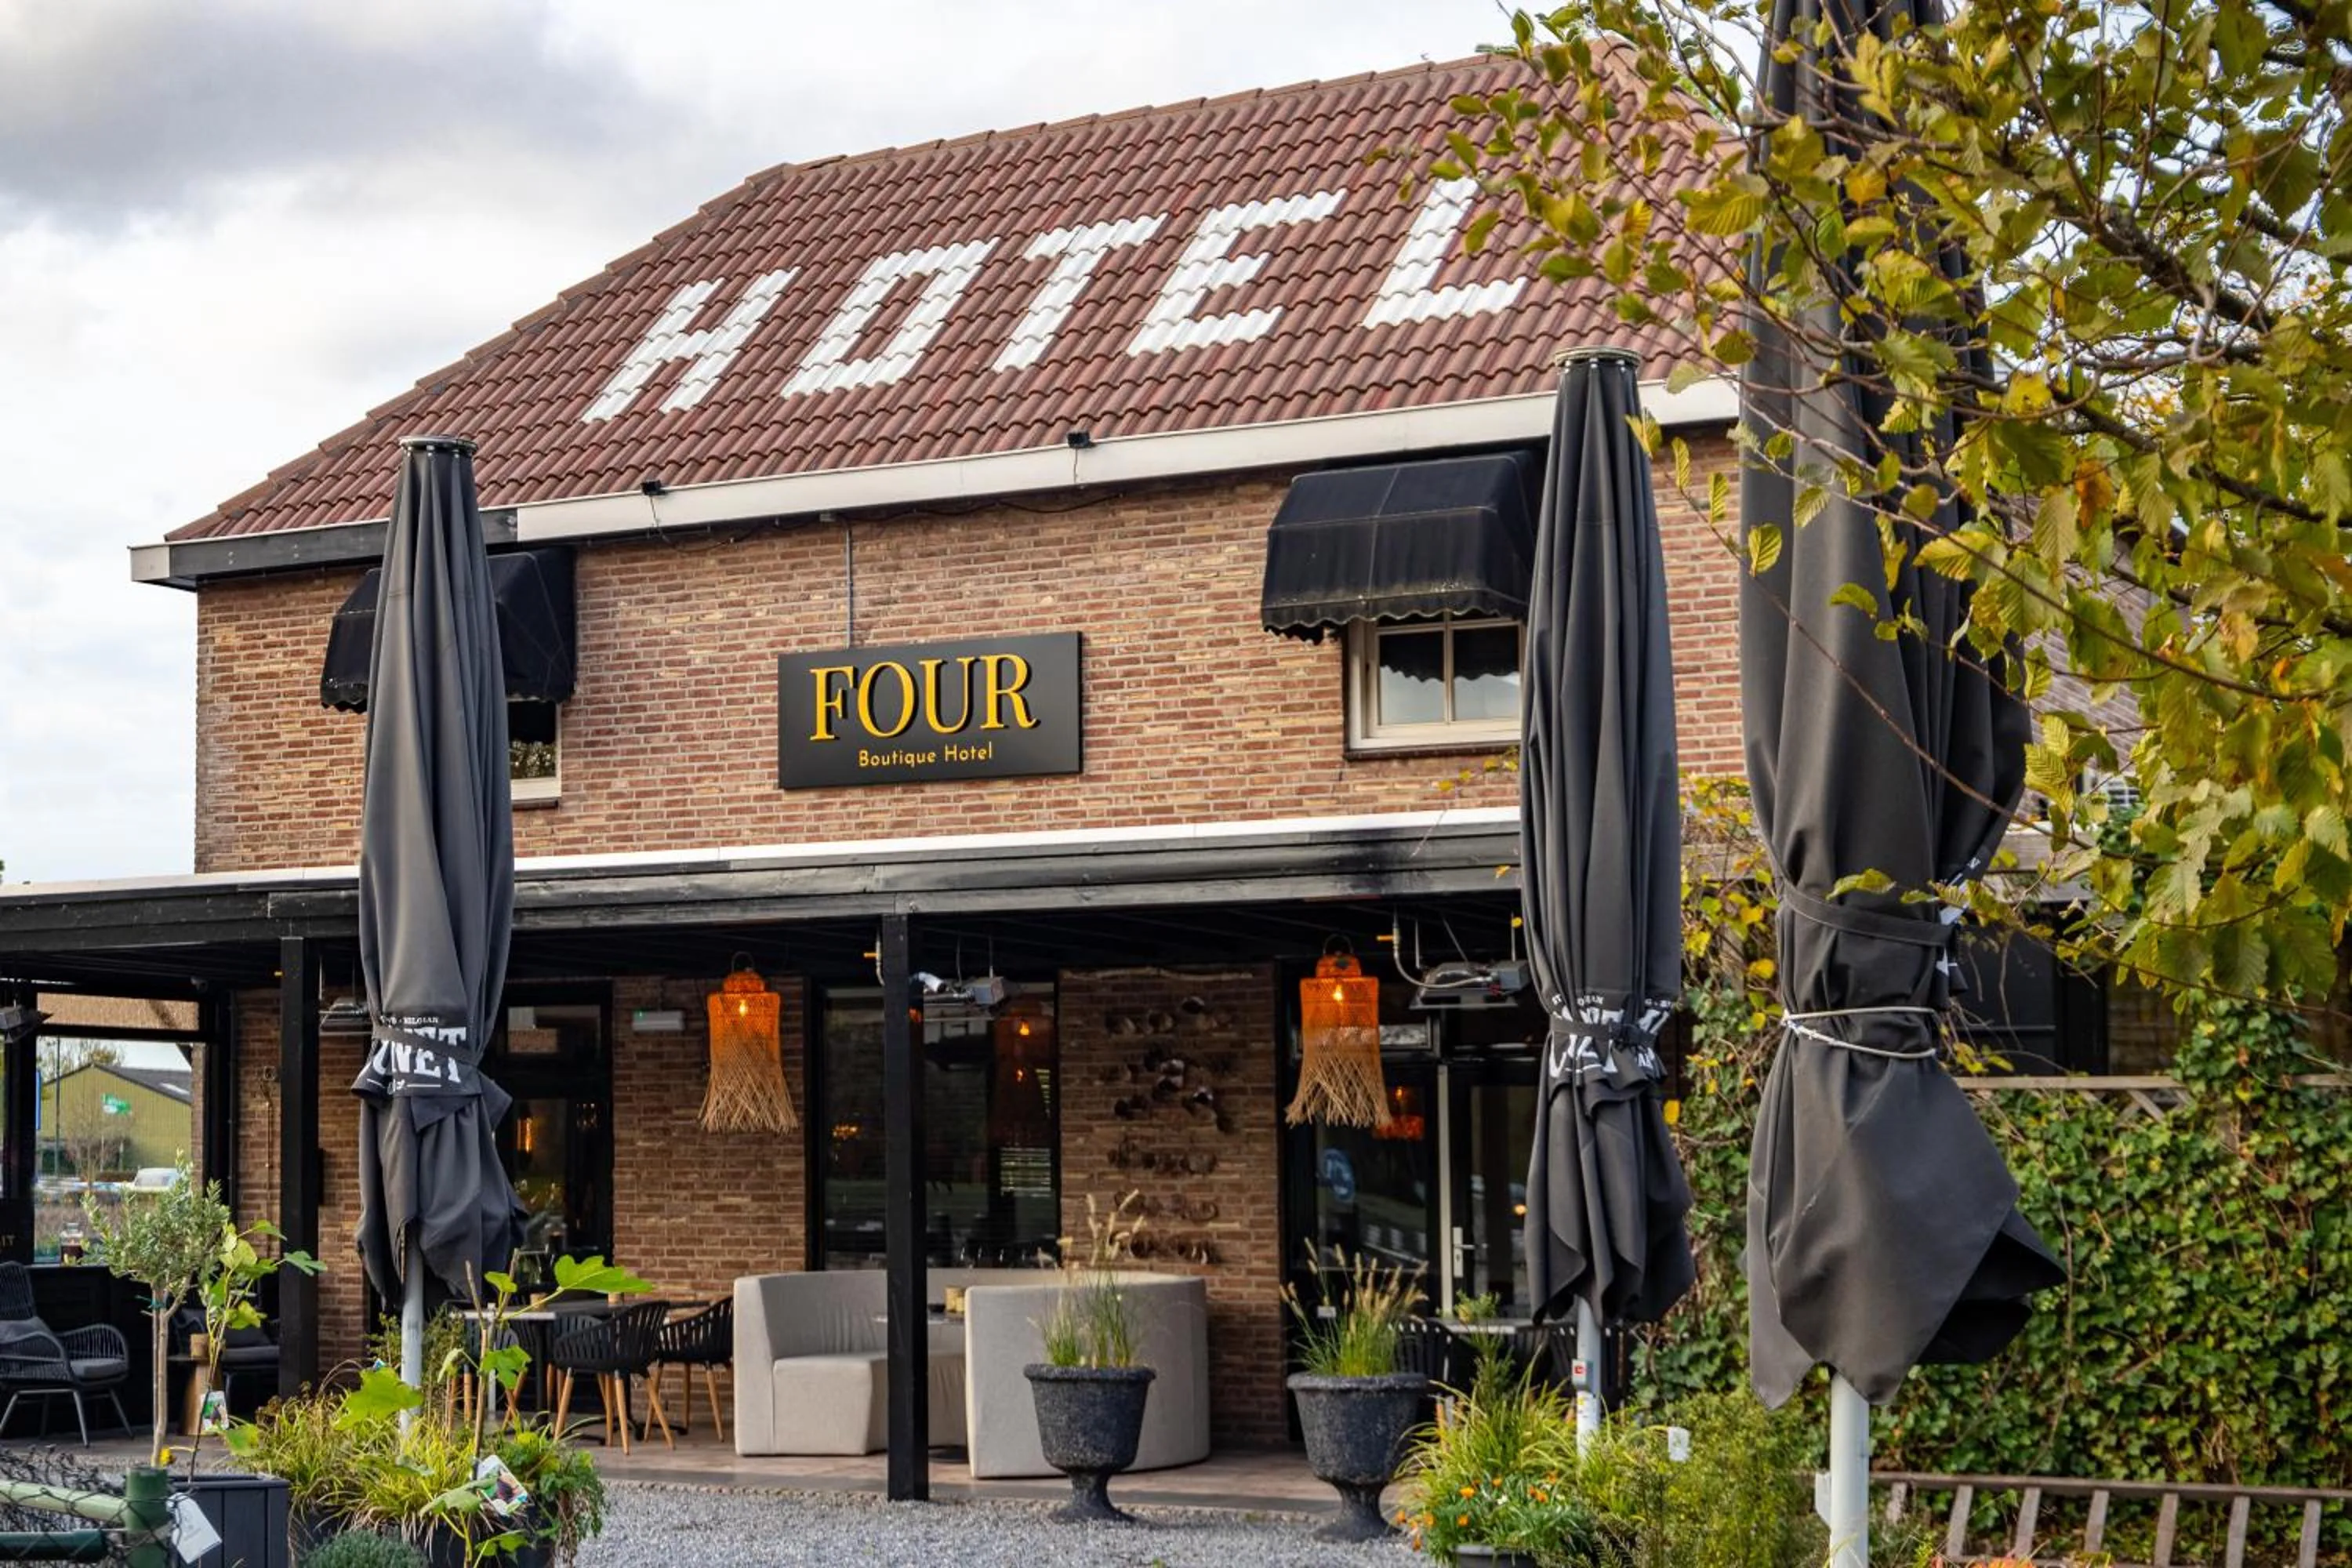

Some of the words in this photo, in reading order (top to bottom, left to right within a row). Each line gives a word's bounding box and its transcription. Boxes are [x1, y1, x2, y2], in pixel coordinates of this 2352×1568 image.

[580, 177, 1527, 423] HOTEL
[809, 653, 1038, 742] FOUR
[858, 750, 937, 768] Boutique
[944, 741, 993, 762] Hotel
